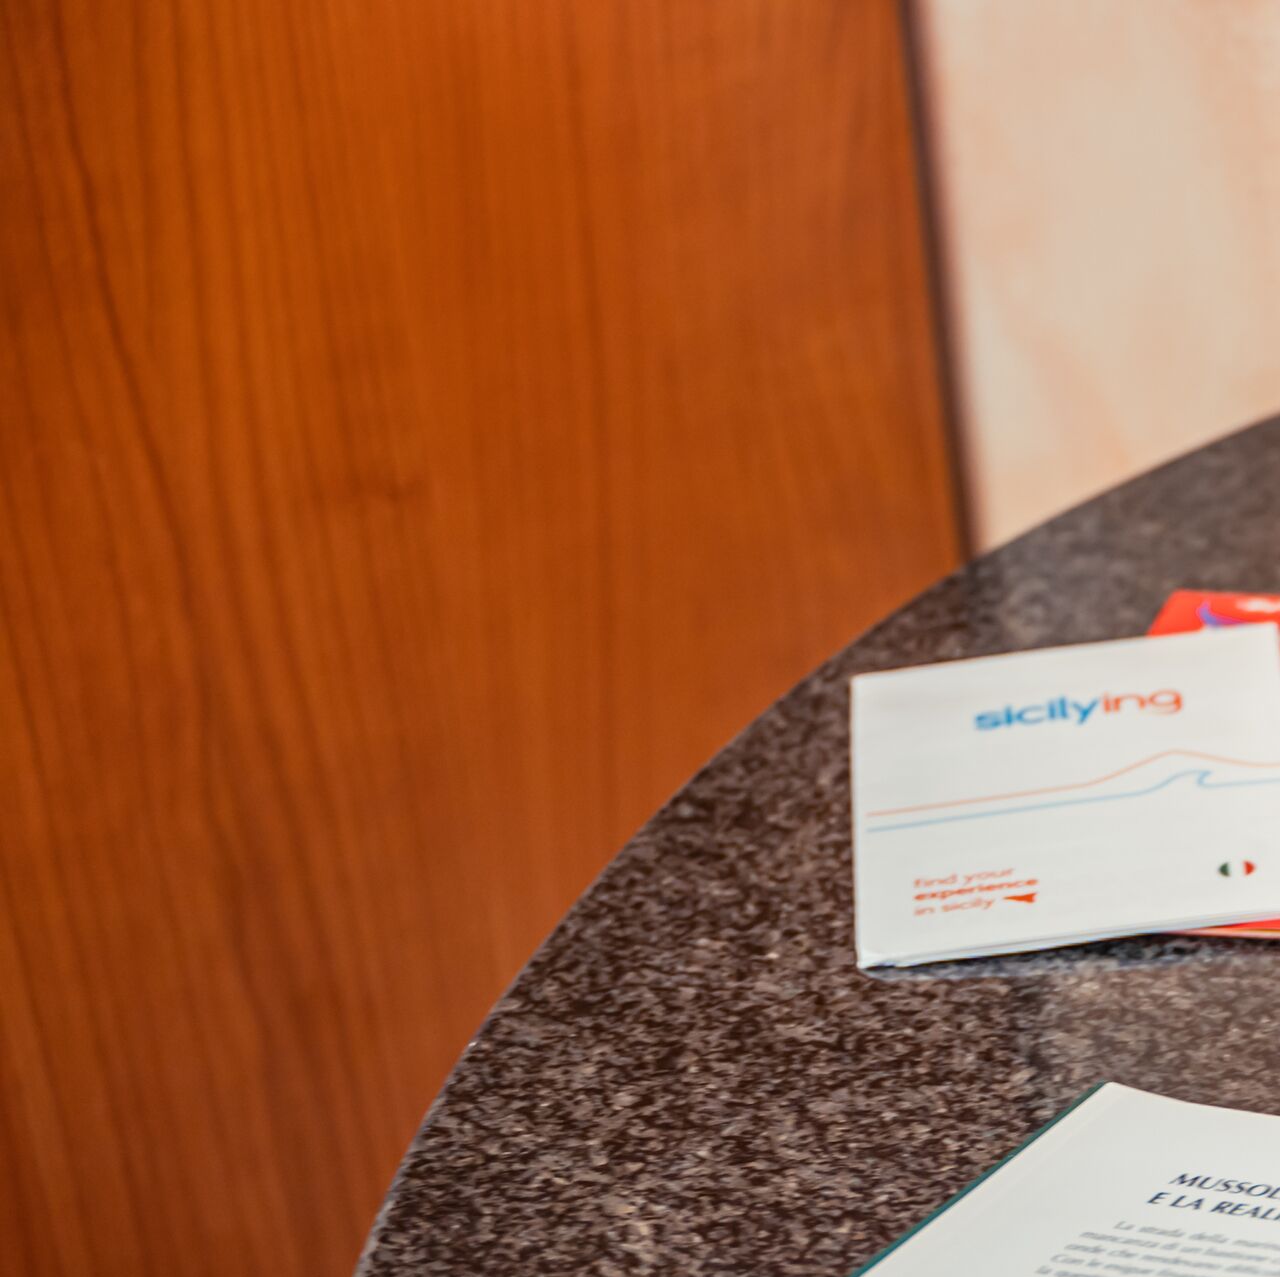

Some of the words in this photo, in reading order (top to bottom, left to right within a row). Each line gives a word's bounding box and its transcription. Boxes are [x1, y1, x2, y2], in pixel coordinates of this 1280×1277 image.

[974, 688, 1183, 731] sicilying
[913, 873, 958, 888] find
[963, 867, 1014, 886] your
[914, 878, 1039, 902] experience
[914, 906, 936, 917] in
[942, 897, 997, 913] sicily
[1146, 1191, 1170, 1206] E
[1170, 1194, 1203, 1211] LA
